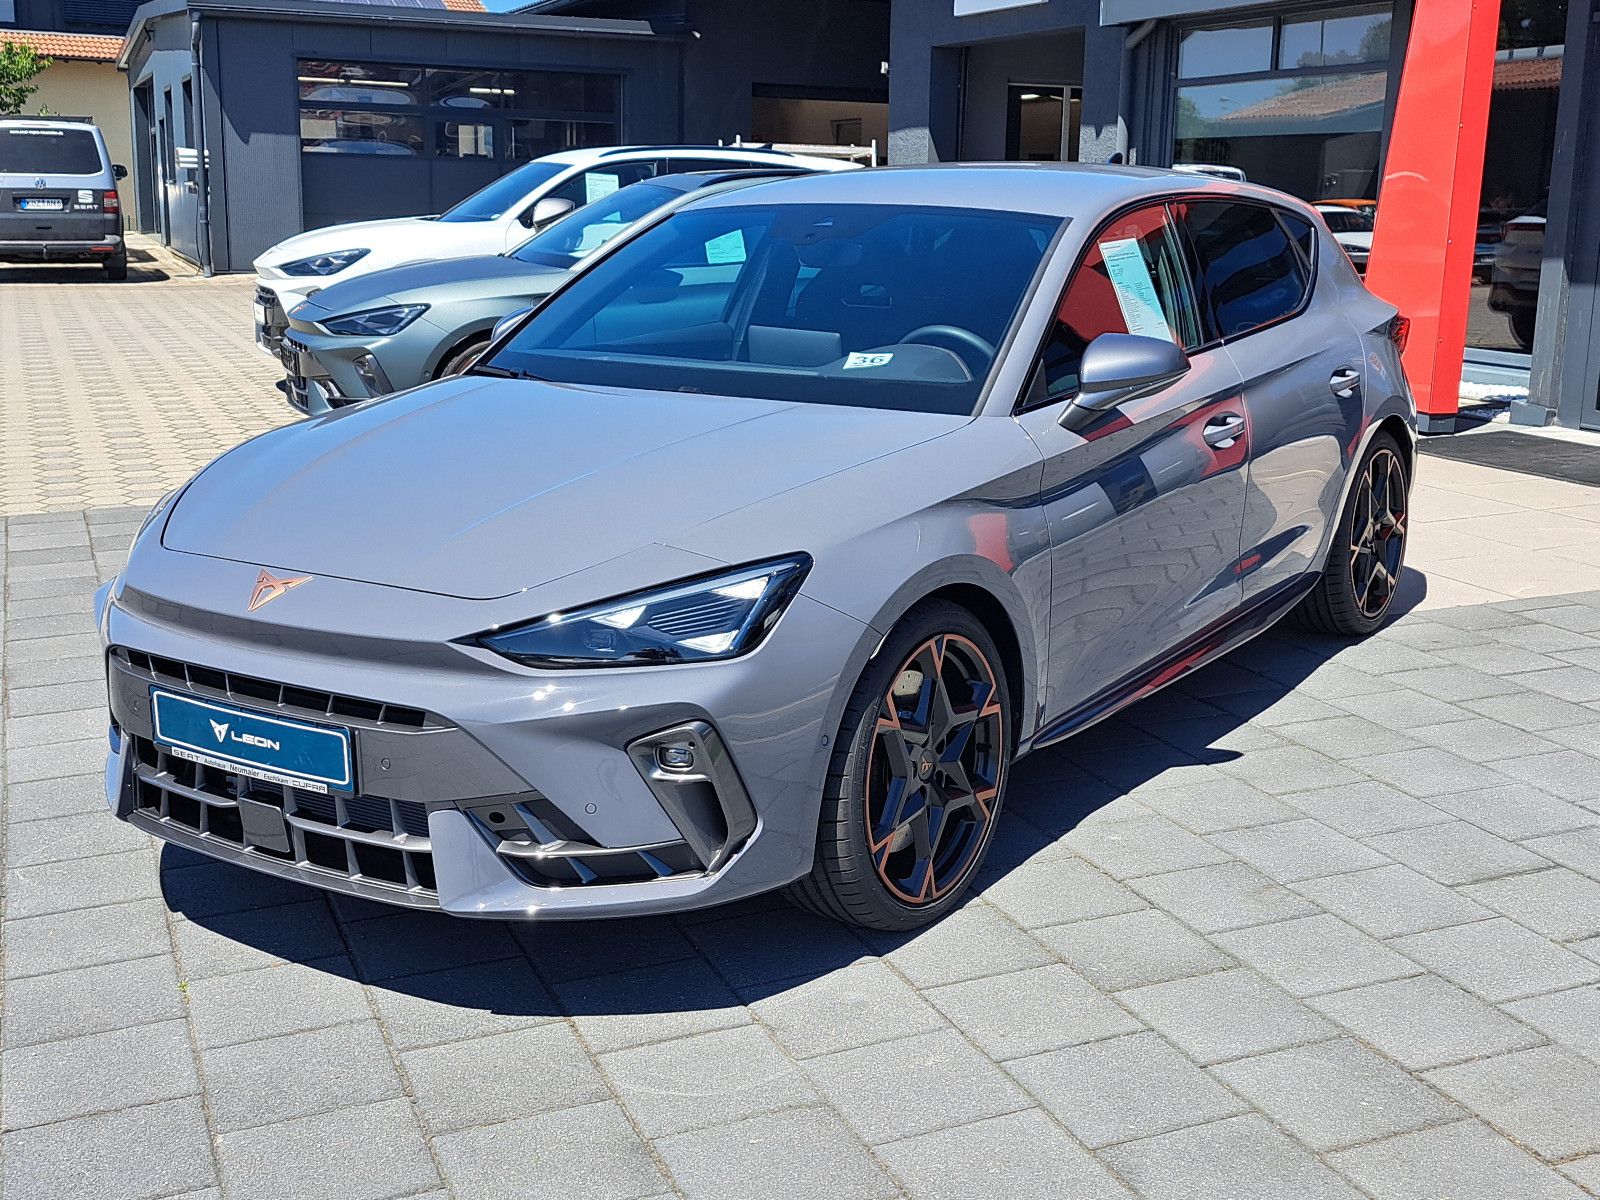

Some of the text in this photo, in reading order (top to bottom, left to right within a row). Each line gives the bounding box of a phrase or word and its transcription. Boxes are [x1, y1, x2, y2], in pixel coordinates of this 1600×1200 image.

[852, 355, 886, 366] 36
[230, 730, 280, 751] LEON
[173, 748, 200, 762] SEAT
[203, 757, 226, 769] Autohaus
[229, 763, 260, 778] Neumaier
[292, 779, 326, 793] CUPRA
